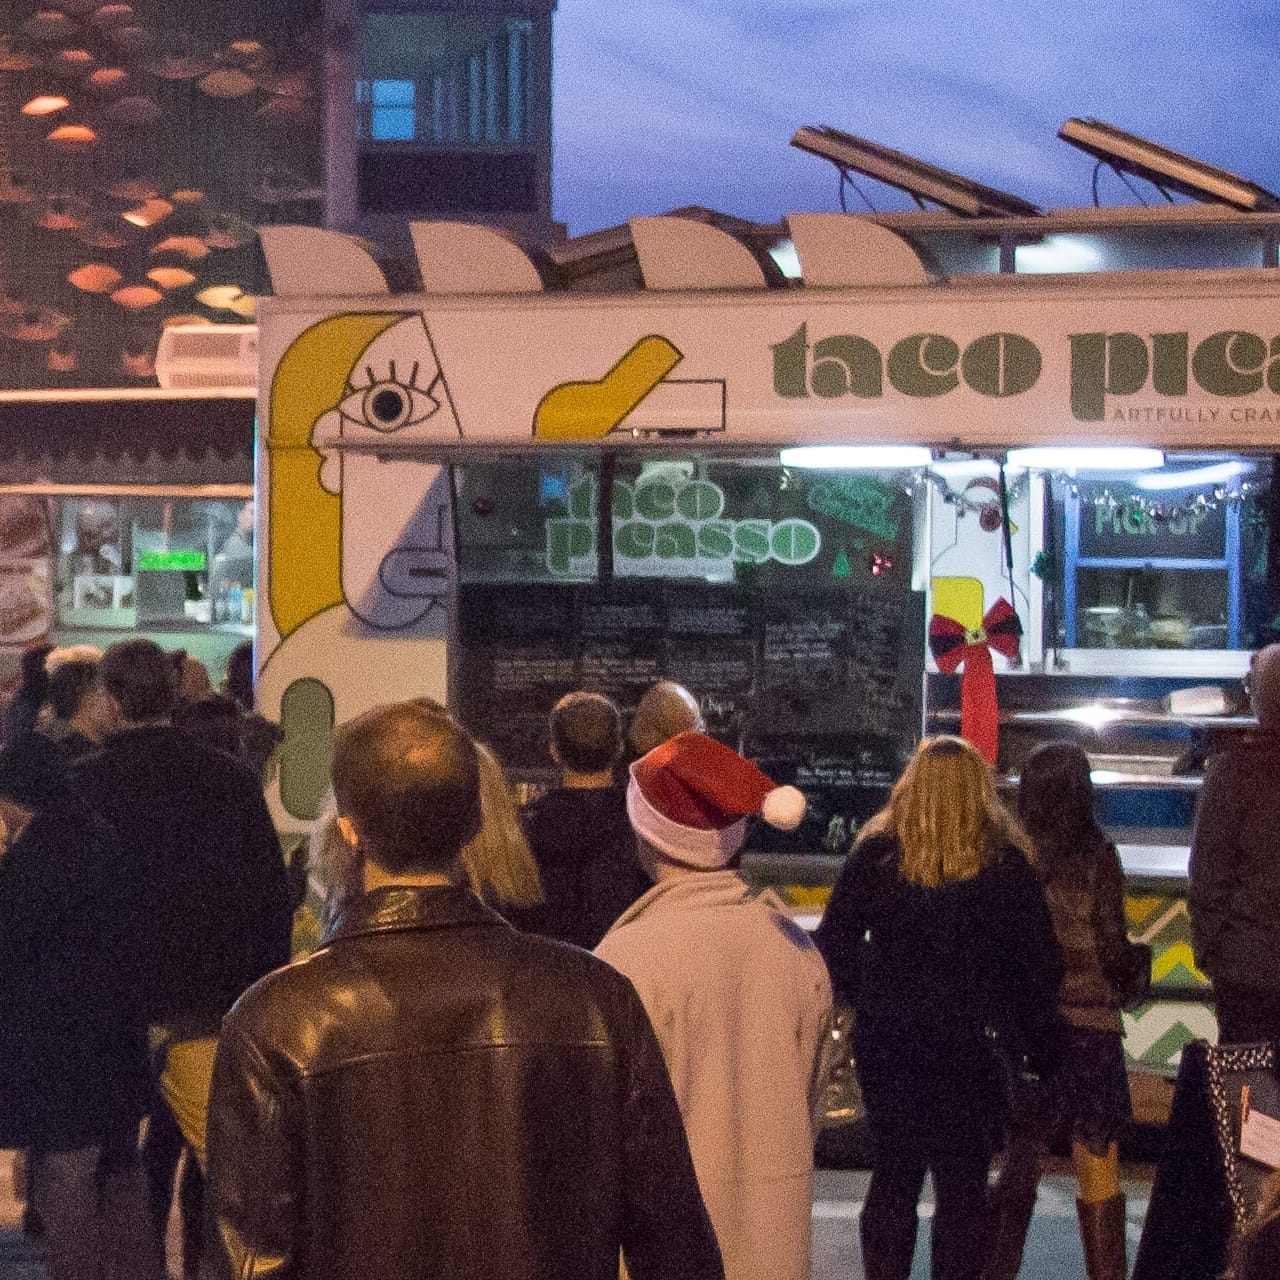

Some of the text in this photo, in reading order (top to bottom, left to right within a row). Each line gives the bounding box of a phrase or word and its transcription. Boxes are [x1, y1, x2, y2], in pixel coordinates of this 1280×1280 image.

[768, 320, 1280, 421] taco pica
[1113, 407, 1220, 422] ARTFULLY
